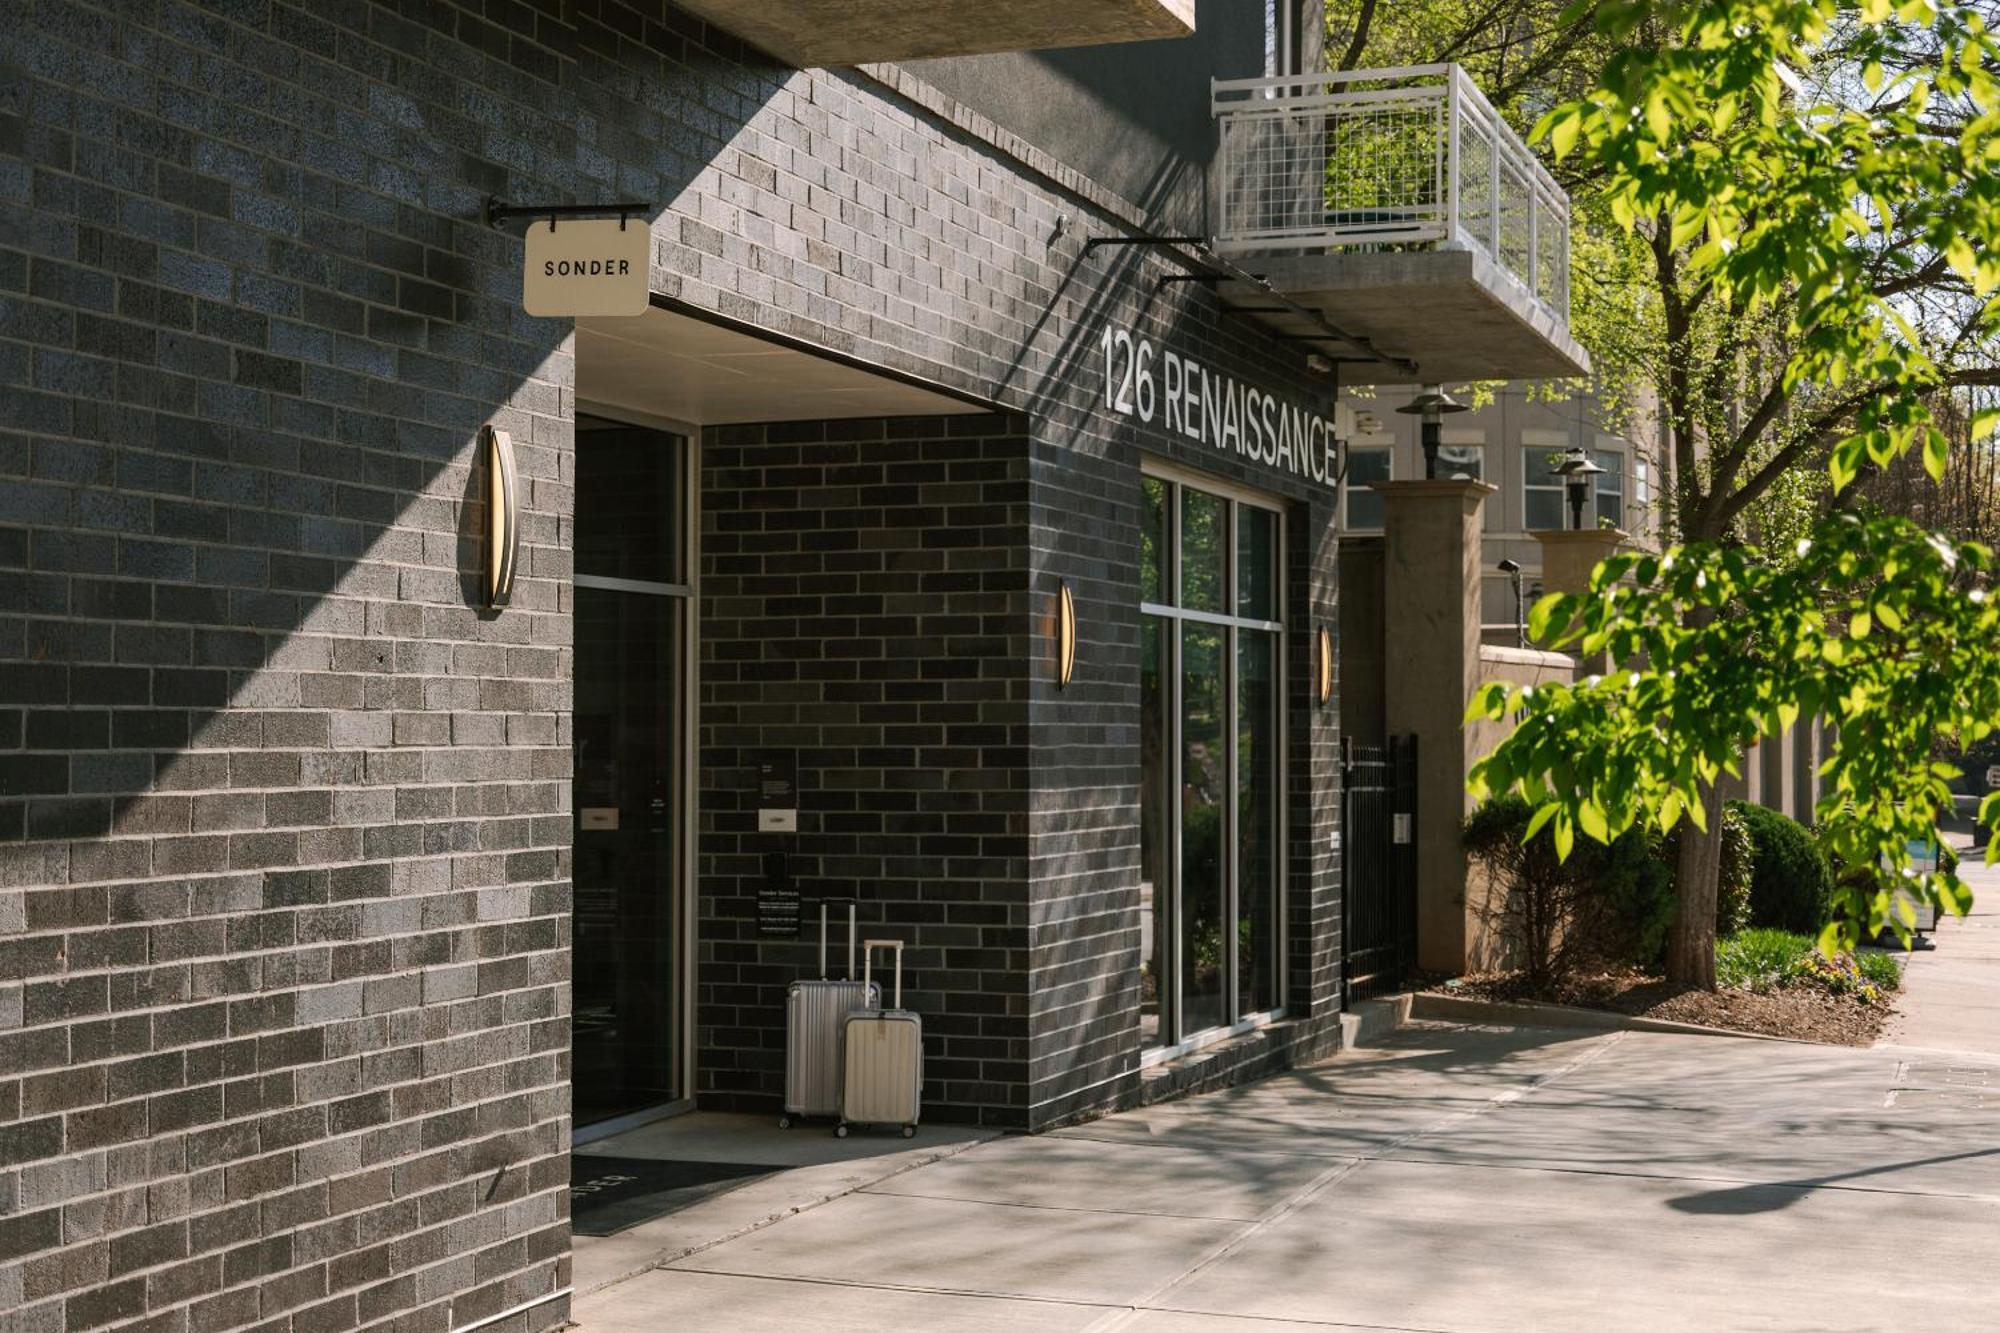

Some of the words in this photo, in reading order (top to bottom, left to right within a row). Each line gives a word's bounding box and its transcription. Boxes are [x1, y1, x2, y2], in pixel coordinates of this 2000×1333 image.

[544, 260, 629, 276] SONDER
[1101, 325, 1155, 423] 126
[1164, 350, 1336, 487] RENAISSANCE
